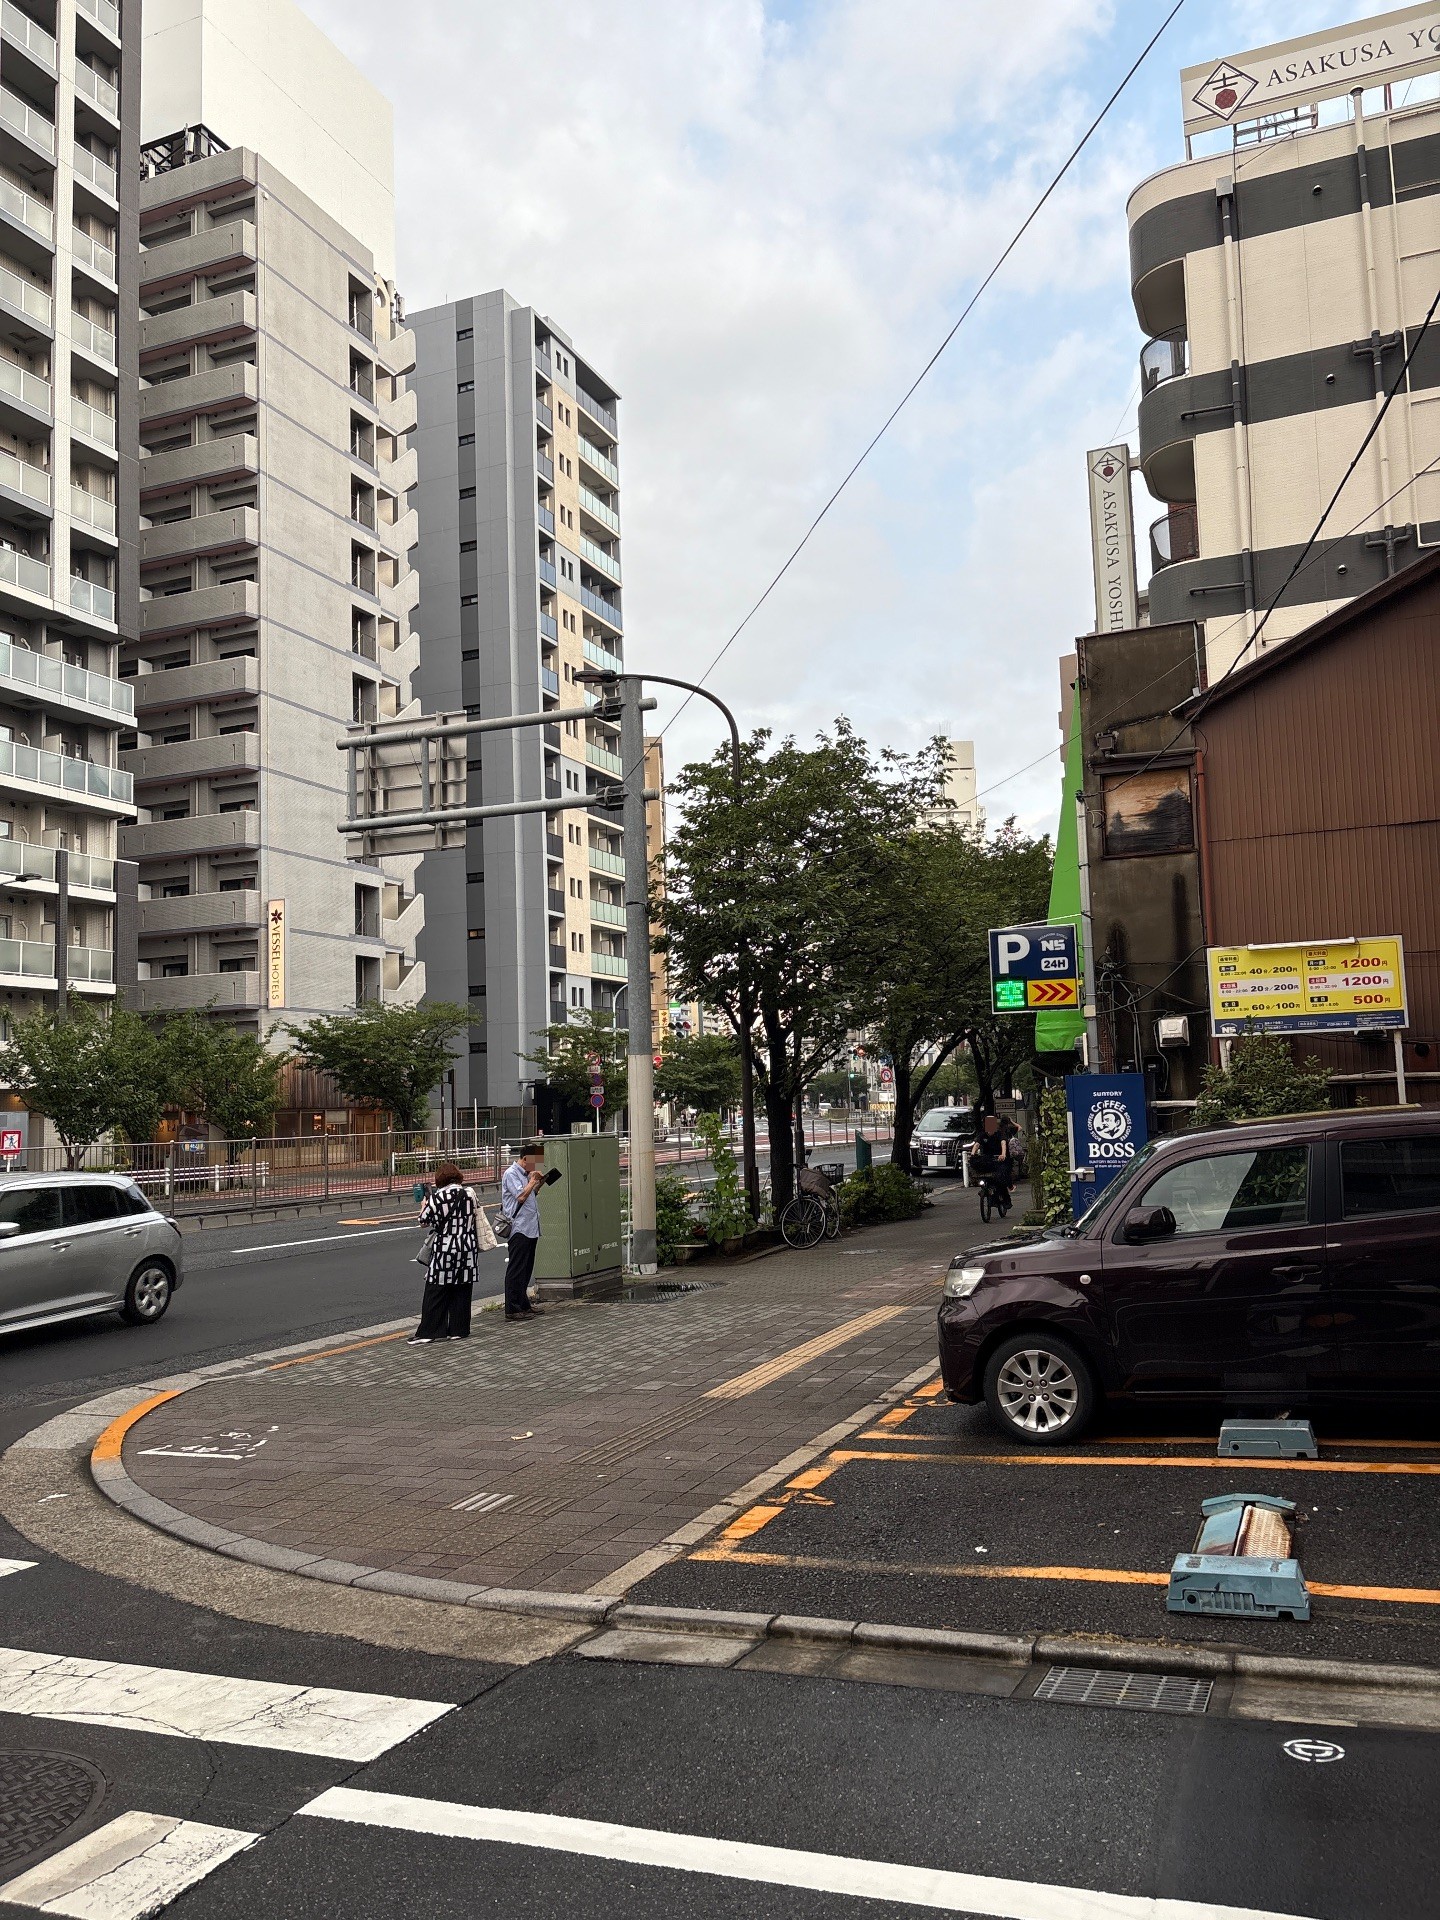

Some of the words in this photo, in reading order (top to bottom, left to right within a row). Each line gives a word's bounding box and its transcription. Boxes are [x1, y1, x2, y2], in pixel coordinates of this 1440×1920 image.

[1266, 40, 1394, 87] ASAKUSA
[1102, 489, 1120, 569] ASAKUSA
[1108, 577, 1124, 631] YOSHI
[272, 925, 280, 963] VESSEL
[998, 934, 1030, 974] P
[1040, 939, 1066, 951] NS
[271, 964, 279, 1000] HOTELS
[1044, 960, 1066, 969] 24H
[1221, 1026, 1237, 1034] NS
[1091, 1100, 1127, 1114] COFFEE
[1088, 1142, 1136, 1158] BOSS
